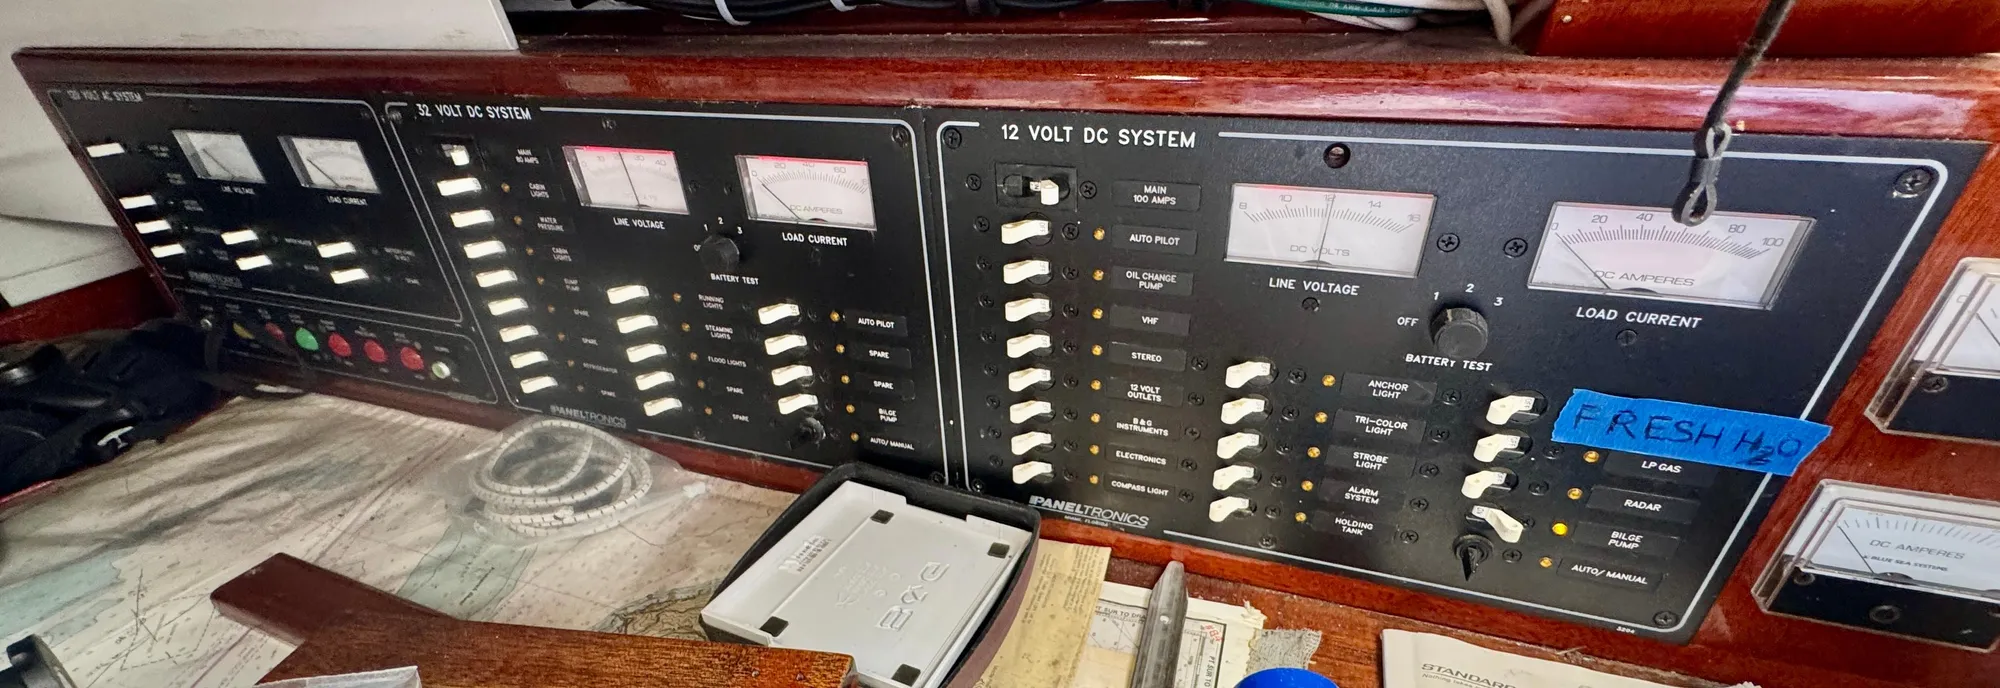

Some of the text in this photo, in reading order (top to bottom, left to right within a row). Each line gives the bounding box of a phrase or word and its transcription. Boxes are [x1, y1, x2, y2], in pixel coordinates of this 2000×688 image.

[416, 104, 532, 121] 32 VOLT DC SYSTEM
[1001, 124, 1196, 148] 12 VOLT DC SYSTEM
[774, 162, 786, 170] 20
[834, 166, 846, 174] 60
[1144, 185, 1167, 195] MAIN
[1133, 194, 1176, 206] 100 AMPS
[789, 204, 843, 214] DC AMPERES
[1238, 201, 1248, 210] 8
[1278, 194, 1292, 202] 10
[1368, 200, 1382, 210] 14
[1408, 214, 1421, 223] 16
[613, 218, 666, 230] LINE VOLTAGE
[718, 216, 724, 224] 2
[704, 224, 708, 232] 1
[737, 226, 742, 234] 3
[1550, 212, 1784, 248] 0 20 40 80 100
[782, 232, 848, 247] LOAD CURRENT
[1130, 234, 1180, 246] AUTO PILOT
[1290, 244, 1350, 257] DC VOLTS
[710, 273, 759, 285] BATTERY TEST
[1126, 270, 1177, 284] OIL CHANGE
[1594, 270, 1695, 288] DC AMPERES
[1138, 280, 1164, 290] PUMP
[1269, 277, 1360, 296] LINE VOLTAGE
[1466, 283, 1475, 293] 2
[698, 294, 724, 304] RUNNING
[1434, 291, 1440, 300] 1
[1494, 296, 1504, 306] 3
[703, 302, 724, 310] LIGHTS
[858, 318, 895, 328] AUTO PILOT
[1142, 316, 1158, 325] VHF
[1397, 316, 1419, 328] OFF
[1576, 306, 1702, 329] LOAD CURRENT
[705, 324, 733, 334] STEAMING
[710, 332, 731, 340] LIGHTS
[868, 350, 890, 359] SPARE
[1132, 352, 1162, 363] STEREO
[708, 356, 747, 368] FLOOD LIGHTS
[1405, 353, 1493, 373] BATTERY TEST
[726, 386, 744, 394] SPARE
[874, 380, 894, 390] SPARE
[1130, 384, 1160, 395] 12 VOLT
[1368, 380, 1409, 392] ANCHOR
[1127, 390, 1162, 403] OUTLETS
[1372, 388, 1401, 400] LIGHT
[550, 404, 627, 429] PANELTRONICS
[732, 414, 749, 422] SPARE
[878, 408, 896, 416] BILGE
[880, 414, 898, 422] PUMP
[1354, 416, 1408, 430] TRI-COLOR
[1572, 404, 1725, 449] FRESH
[1116, 422, 1169, 437] INSTRUMENTS
[1366, 426, 1393, 436] LIGHT
[870, 437, 914, 450] AUTO/ MANUAL
[1116, 450, 1166, 466] ELECTRONICS
[1352, 452, 1388, 464] STROBE
[1356, 460, 1382, 471] LIGHT
[1641, 460, 1682, 474] LP GAS
[1112, 480, 1169, 496] COMPASS LIGHT
[1348, 486, 1378, 497] ALARM
[1344, 492, 1379, 505] SYSTEM
[1028, 495, 1150, 527] PANELTRONICS
[1624, 499, 1662, 512] RADAR
[1334, 517, 1374, 531] HOLDING
[1342, 526, 1364, 536] TANK
[1610, 531, 1644, 544] BILGE
[1608, 539, 1640, 550] PUMP
[1869, 539, 1966, 560] DC AMPERES
[1870, 556, 1892, 564] BLUE
[1913, 562, 1949, 572] SYSTEMS
[1571, 564, 1648, 585] AUTO/ MANUAL
[1616, 626, 1636, 634] 3204
[1422, 673, 1450, 684] Nothing
